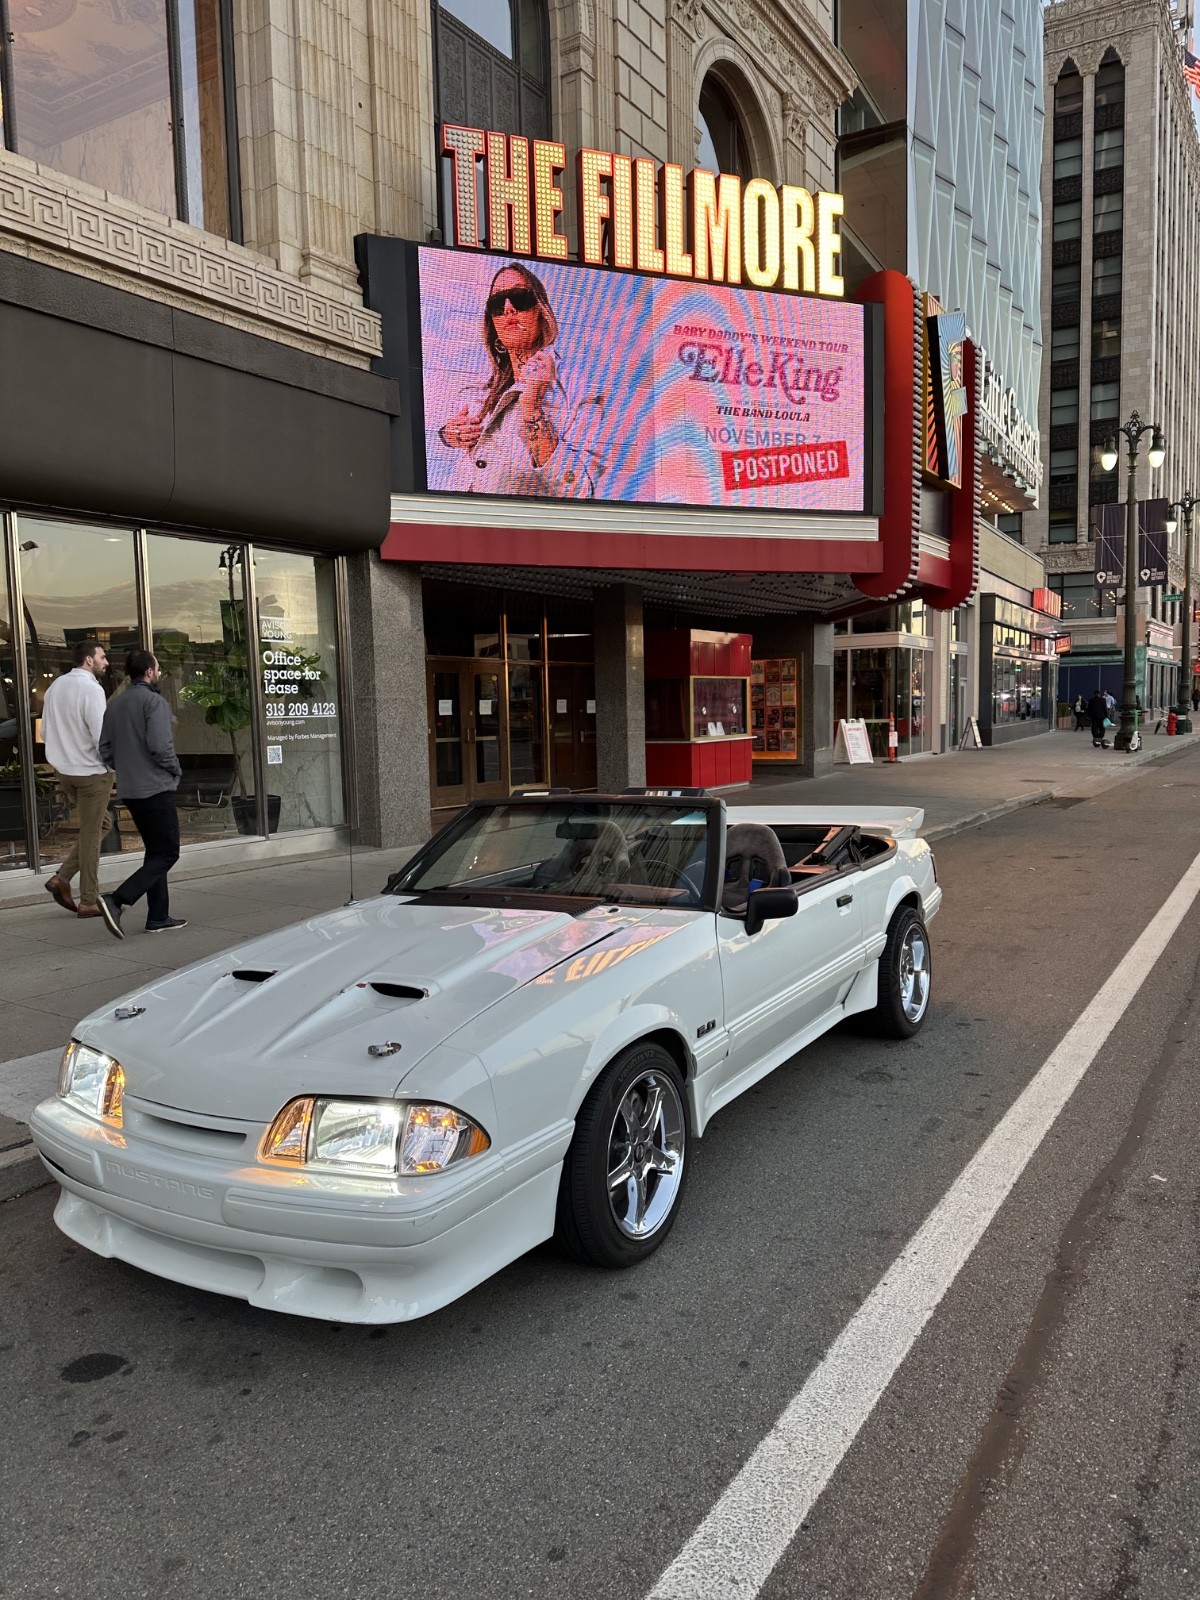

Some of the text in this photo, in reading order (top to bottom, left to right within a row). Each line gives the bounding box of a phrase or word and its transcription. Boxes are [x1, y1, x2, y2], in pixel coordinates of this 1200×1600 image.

[441, 124, 845, 297] THE FILLMORE
[673, 324, 849, 353] BABY DADDY'S WEEKEND TOUR
[678, 341, 843, 405] Elle King
[716, 405, 810, 422] THE BAND LOULA
[705, 426, 807, 447] NOVEMBER
[732, 449, 839, 482] POSTPONED
[261, 620, 292, 631] AVISO
[261, 630, 293, 640] YOUNG
[263, 650, 301, 665] Office
[264, 666, 321, 683] space for
[264, 680, 299, 694] lease
[266, 702, 336, 716] 313 209 4123
[106, 1161, 215, 1200] MUSTANG
